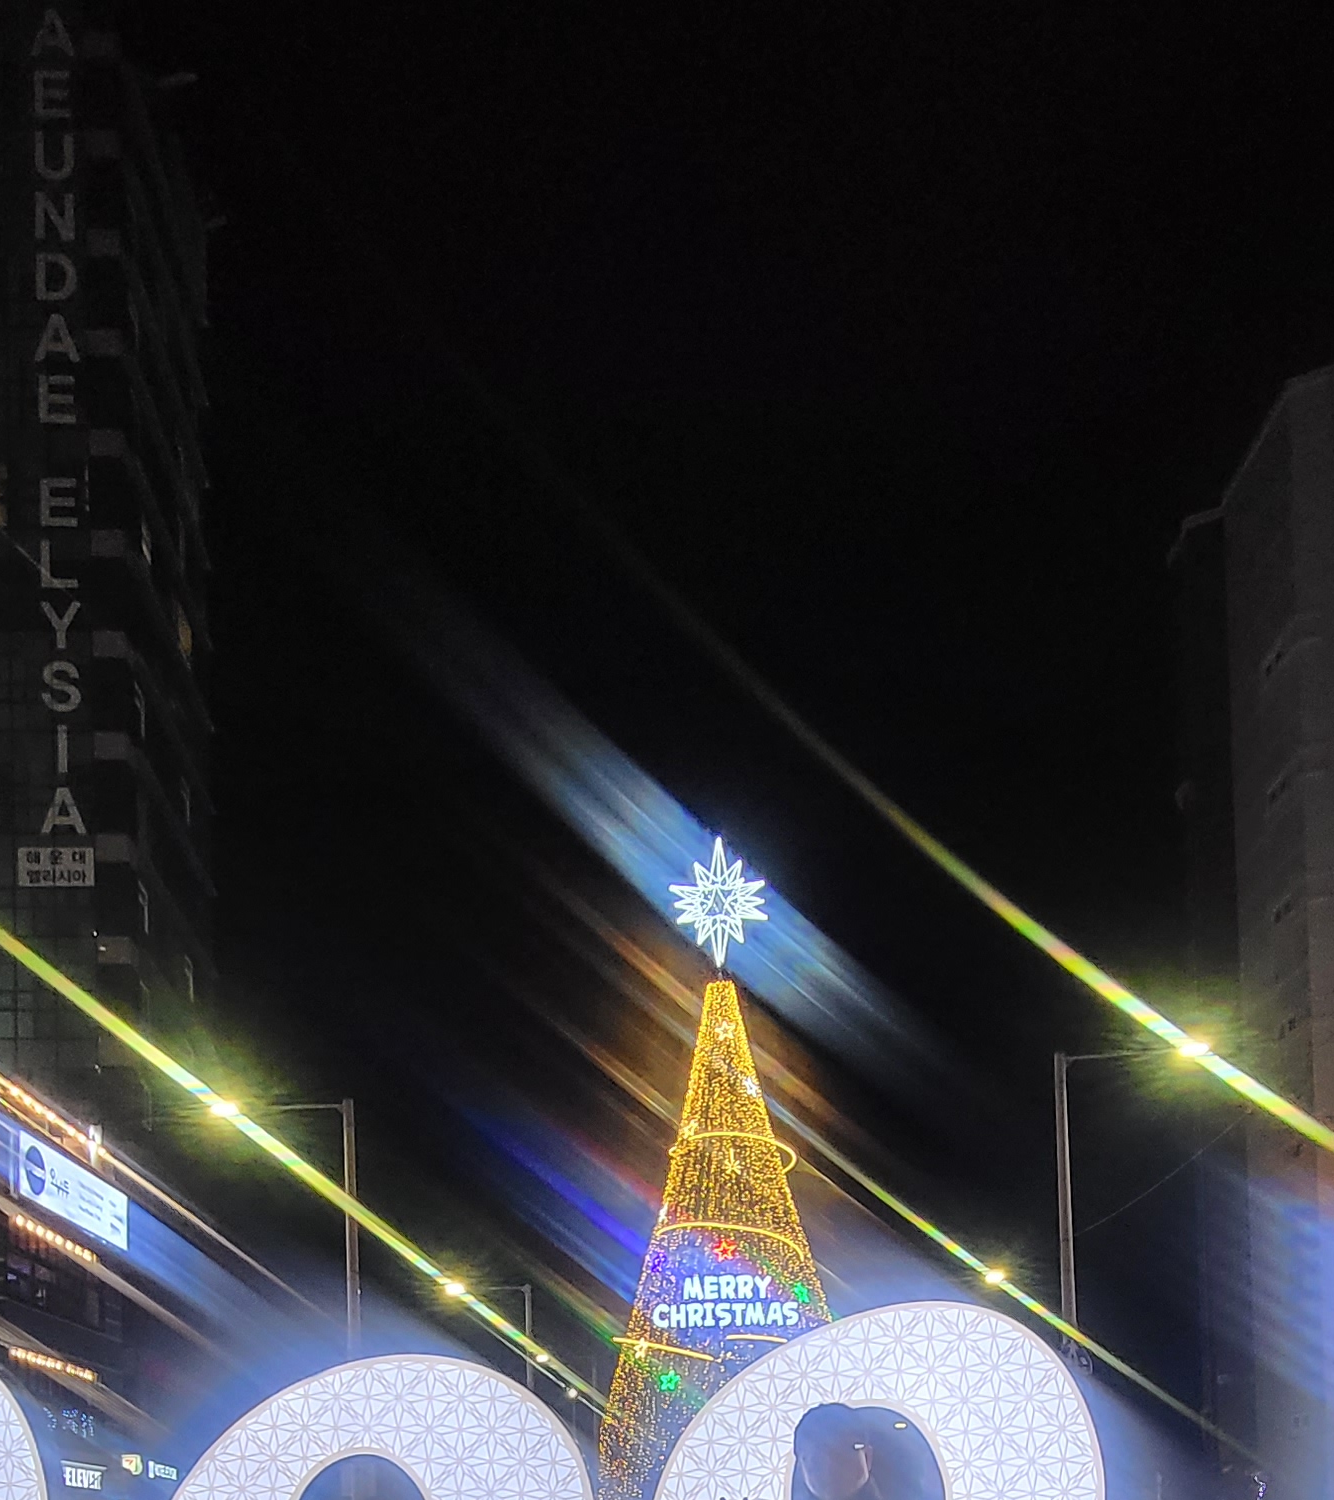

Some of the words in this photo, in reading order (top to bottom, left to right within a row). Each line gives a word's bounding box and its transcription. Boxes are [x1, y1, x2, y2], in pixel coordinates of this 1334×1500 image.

[40, 477, 87, 836] ELYSIA
[683, 1274, 772, 1300] MERRY
[653, 1302, 799, 1328] CHRISTMAS
